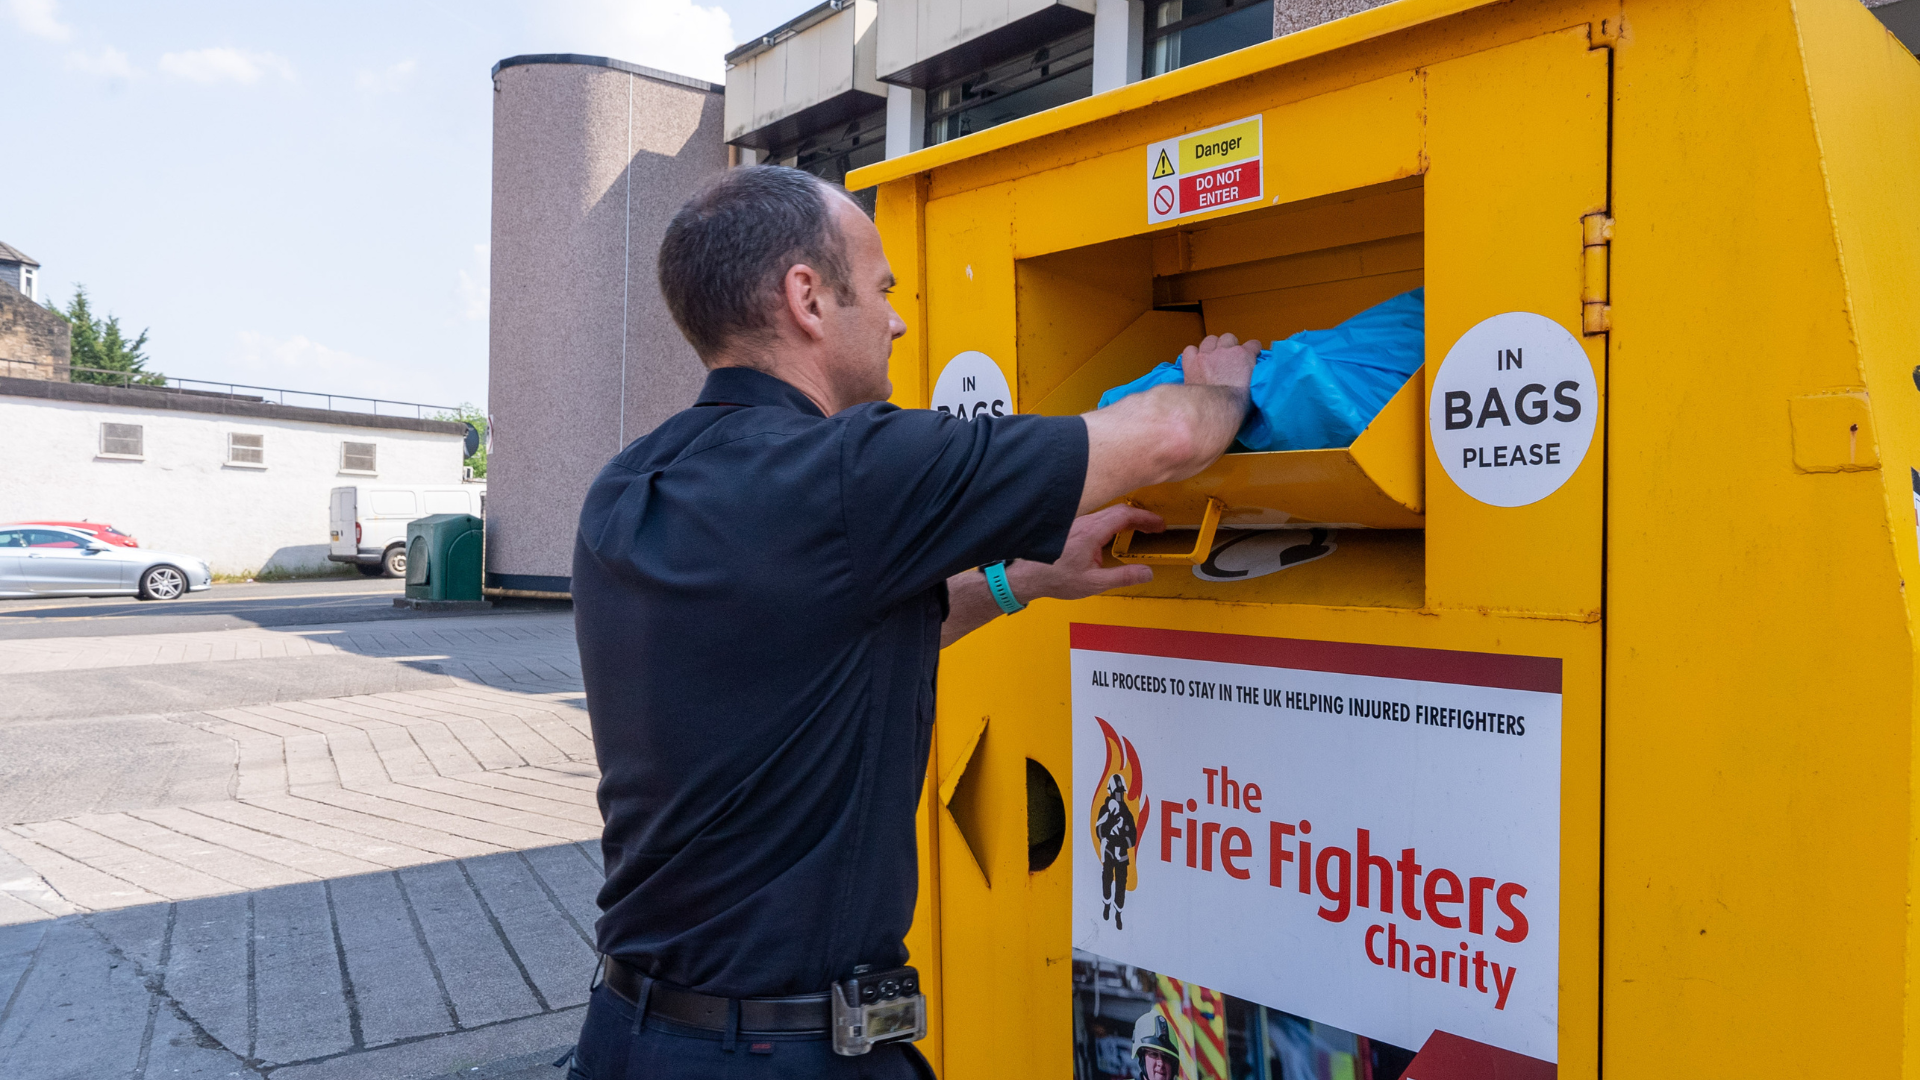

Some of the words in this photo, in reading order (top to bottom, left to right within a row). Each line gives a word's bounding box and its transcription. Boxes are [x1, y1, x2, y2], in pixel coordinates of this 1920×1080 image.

[1195, 137, 1243, 160] Danger
[1196, 175, 1215, 191] DO
[1216, 167, 1242, 186] NOT
[1199, 186, 1239, 207] ENTER
[1497, 347, 1523, 371] IN
[962, 376, 976, 392] IN
[937, 399, 1005, 422] AGS
[1444, 380, 1582, 431] BAGS
[1463, 442, 1561, 469] PLEASE
[1091, 670, 1110, 688] ALL
[1112, 672, 1167, 695] PROCEEDS
[1169, 678, 1185, 696] TO
[1188, 680, 1216, 701] STAY
[1219, 683, 1233, 702] IN
[1235, 685, 1260, 705] THE
[1263, 688, 1282, 708] UK
[1285, 690, 1344, 717] HELPING
[1349, 697, 1411, 723] INJURED
[1416, 704, 1525, 737] FIREFIGHTERS
[1202, 765, 1262, 814] The
[1160, 798, 1253, 880] Fire
[1269, 819, 1529, 944] Fighters
[1364, 922, 1517, 1011] Charity
